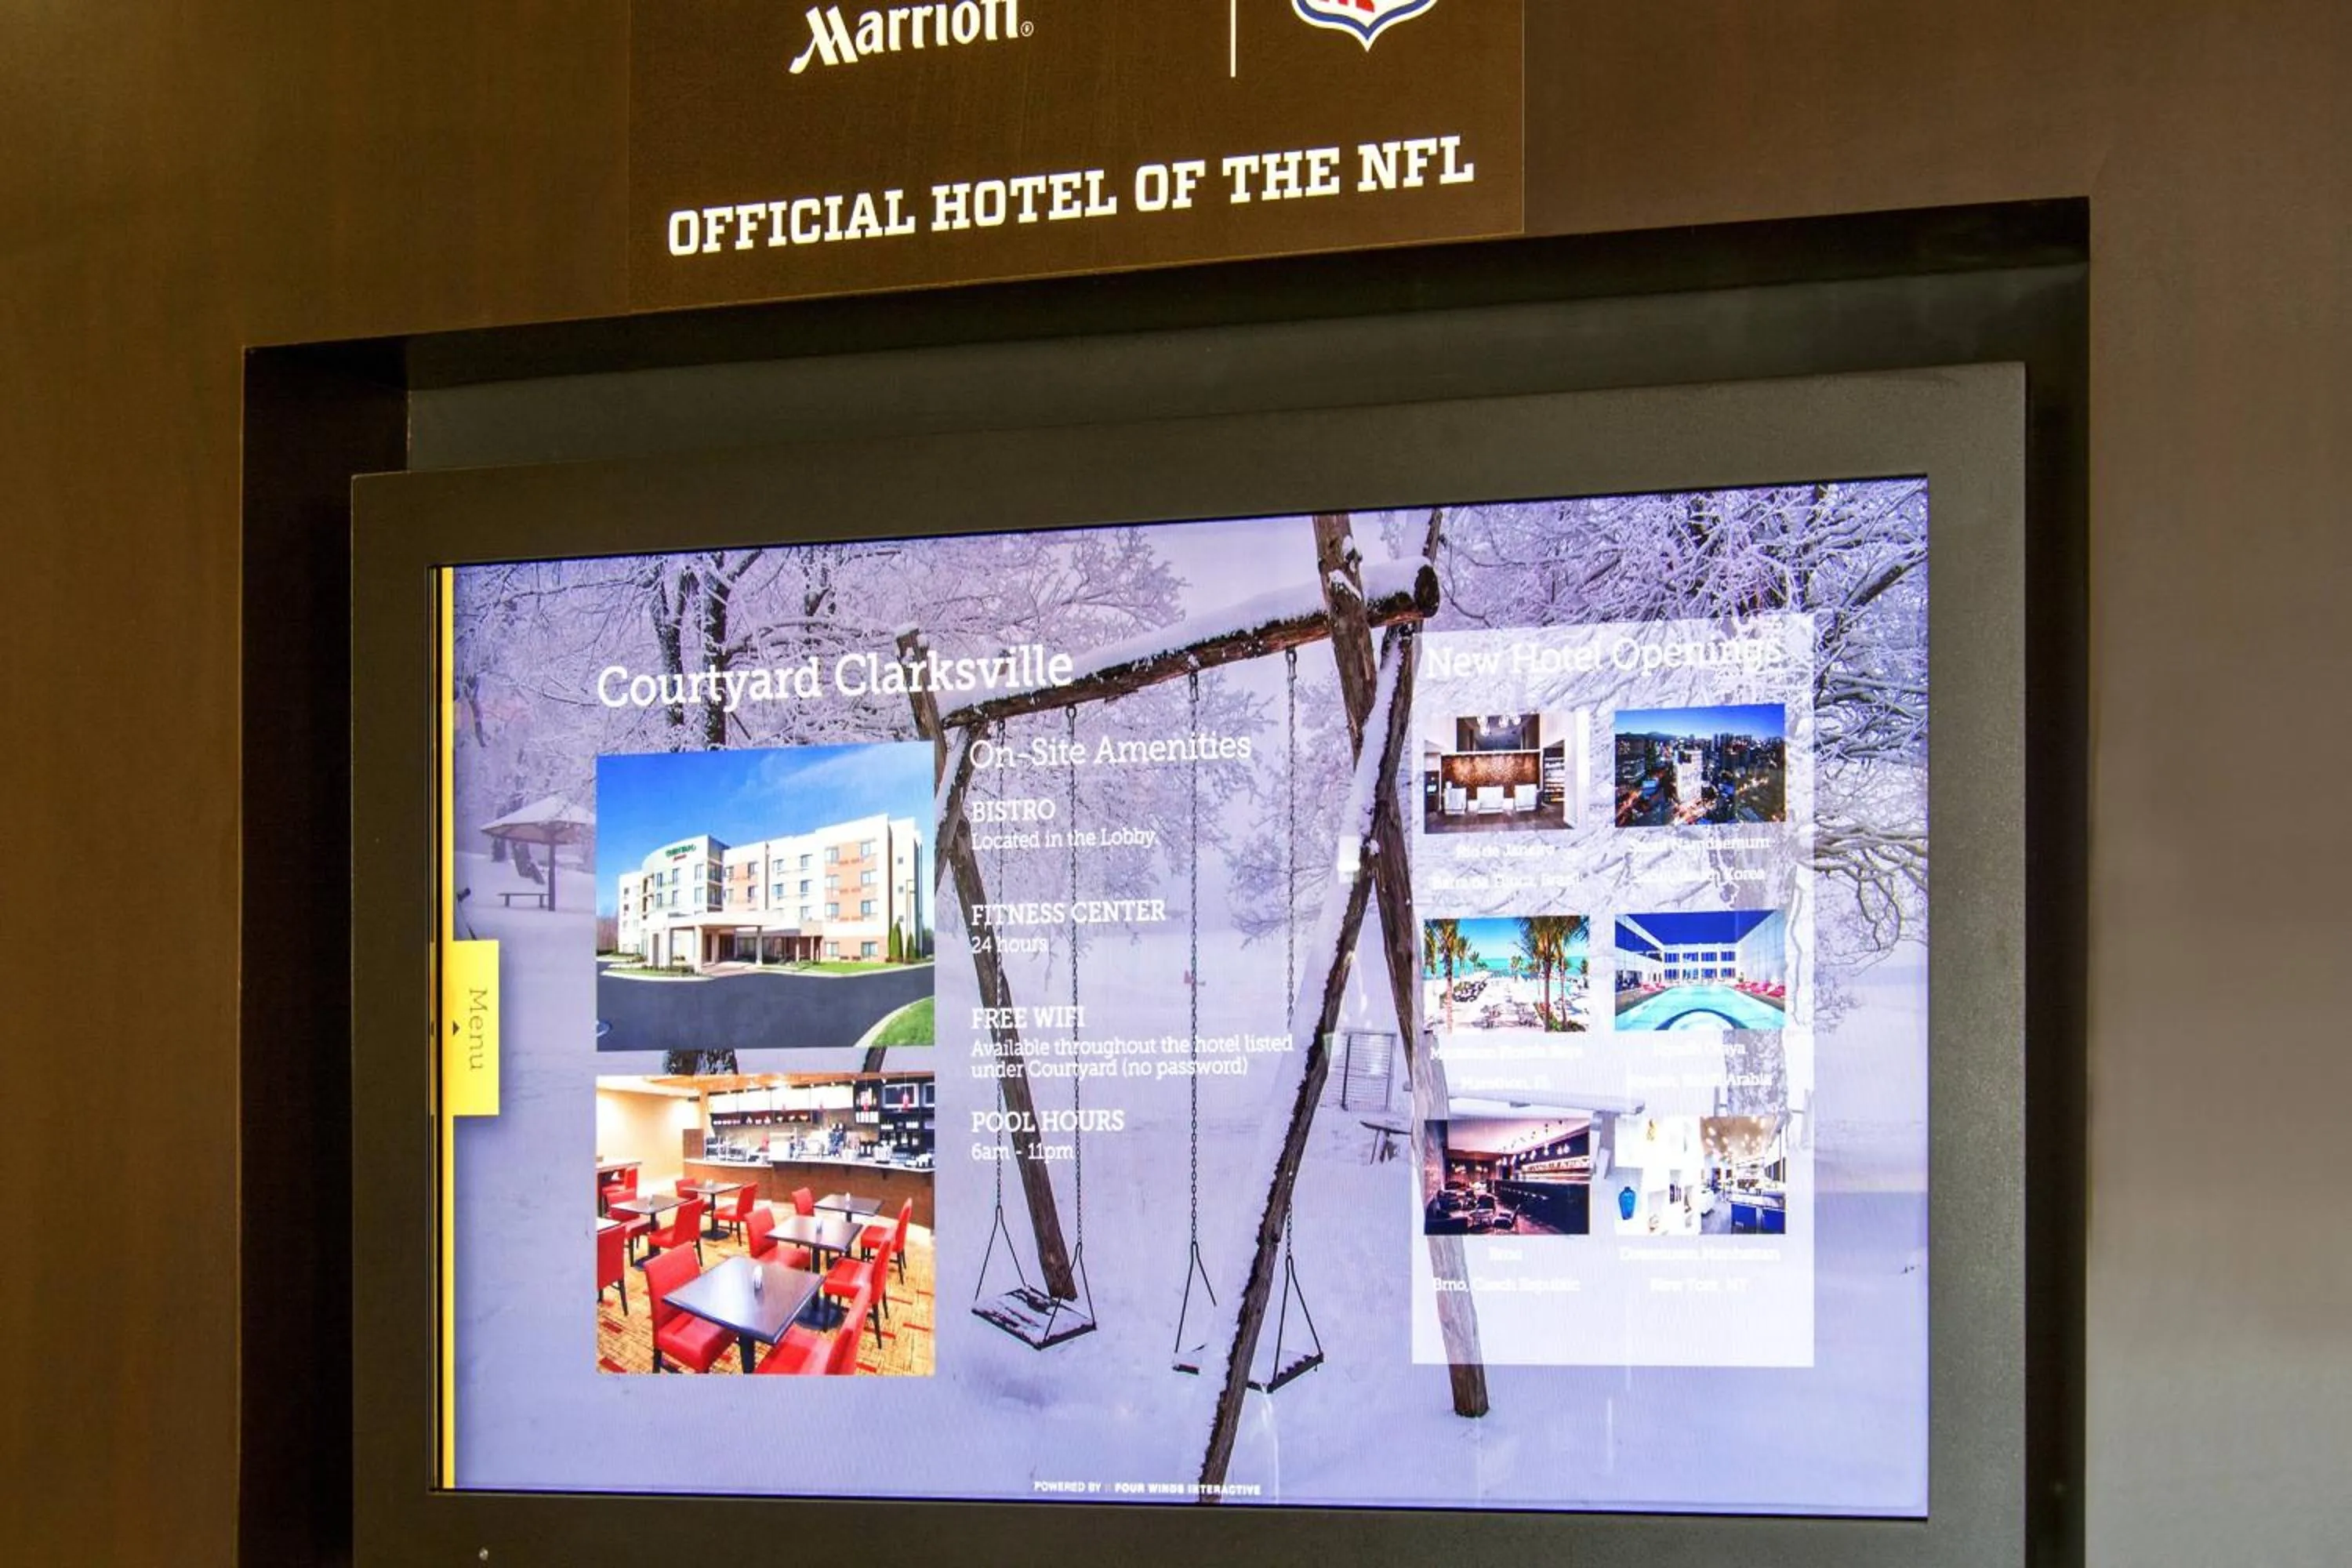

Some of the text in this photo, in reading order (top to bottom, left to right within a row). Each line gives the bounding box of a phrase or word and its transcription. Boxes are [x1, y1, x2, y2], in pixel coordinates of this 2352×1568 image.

[667, 135, 1475, 256] OFFICIAL HOTEL OF THE NFL
[1425, 633, 1783, 679] New Hotel Openings
[597, 644, 1073, 713] Courtyard Clarksville
[970, 733, 1252, 770] On-Site Amenities
[971, 798, 1056, 822] BISTRO
[971, 831, 1040, 851] Located
[1044, 829, 1062, 848] in
[1067, 829, 1096, 847] the
[971, 899, 1167, 927] FITNESS CENTER
[971, 935, 1048, 954] 24 hours
[469, 988, 488, 1071] Menu
[971, 1006, 1084, 1029] FREE WIFI
[971, 1033, 1294, 1058] Available throughout the hotel listed
[971, 1057, 1247, 1080] under Courtyard (no password)
[971, 1109, 1124, 1133] POOL HOURS
[971, 1142, 1011, 1160] 6am
[1028, 1142, 1075, 1164] 11pm
[1034, 1481, 1261, 1496] POWERED BY FOUR WINDS INTERACTIVE
